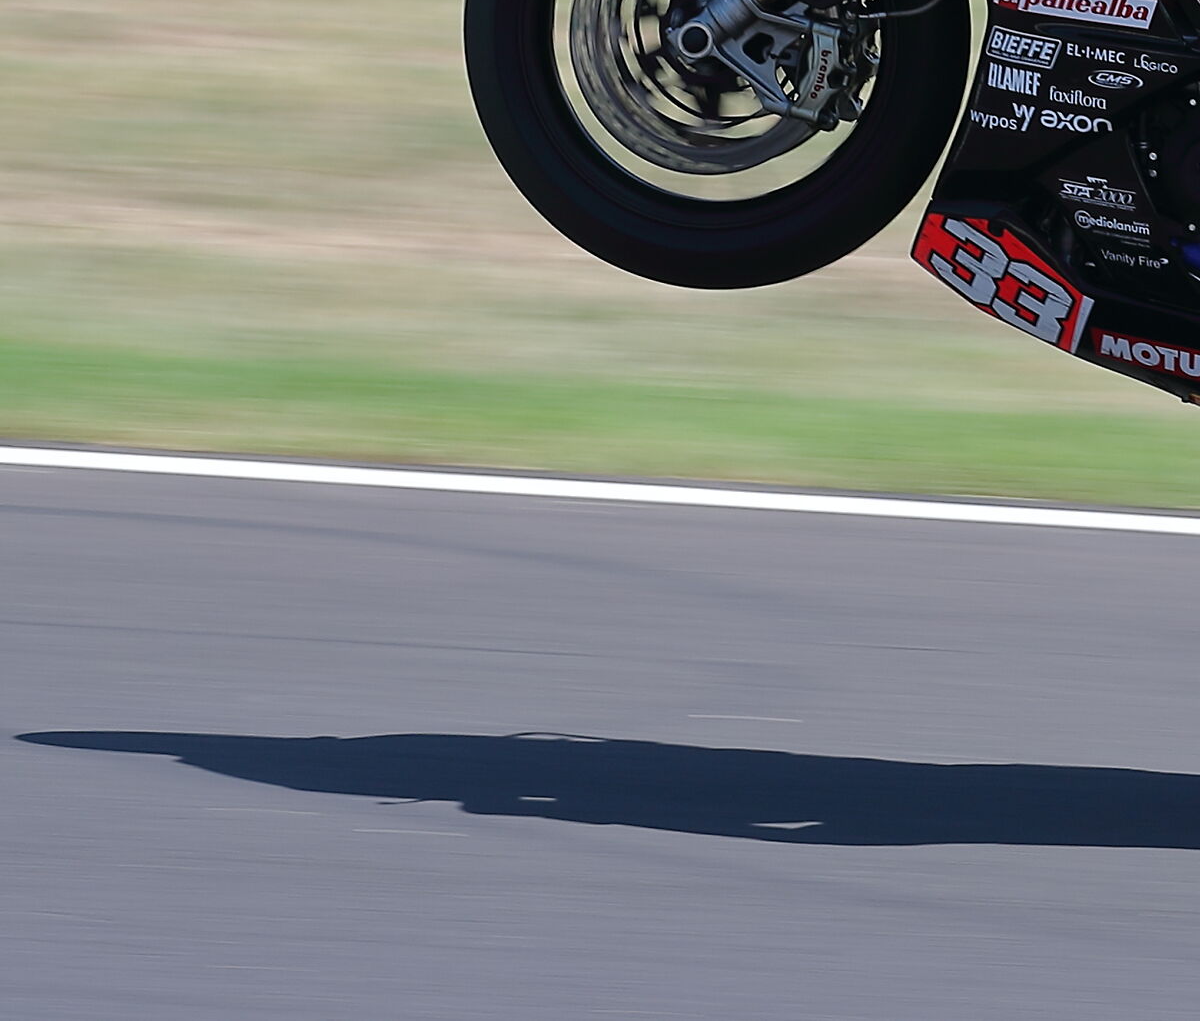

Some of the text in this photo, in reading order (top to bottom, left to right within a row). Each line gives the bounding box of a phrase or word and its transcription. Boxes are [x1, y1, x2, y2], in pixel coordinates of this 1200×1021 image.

[991, 31, 1056, 61] BIEFFE
[810, 49, 833, 99] brembo
[970, 109, 1018, 131] wypos
[1075, 212, 1151, 236] mediolanum
[1101, 248, 1136, 267] Vanity
[929, 219, 1075, 345] 33
